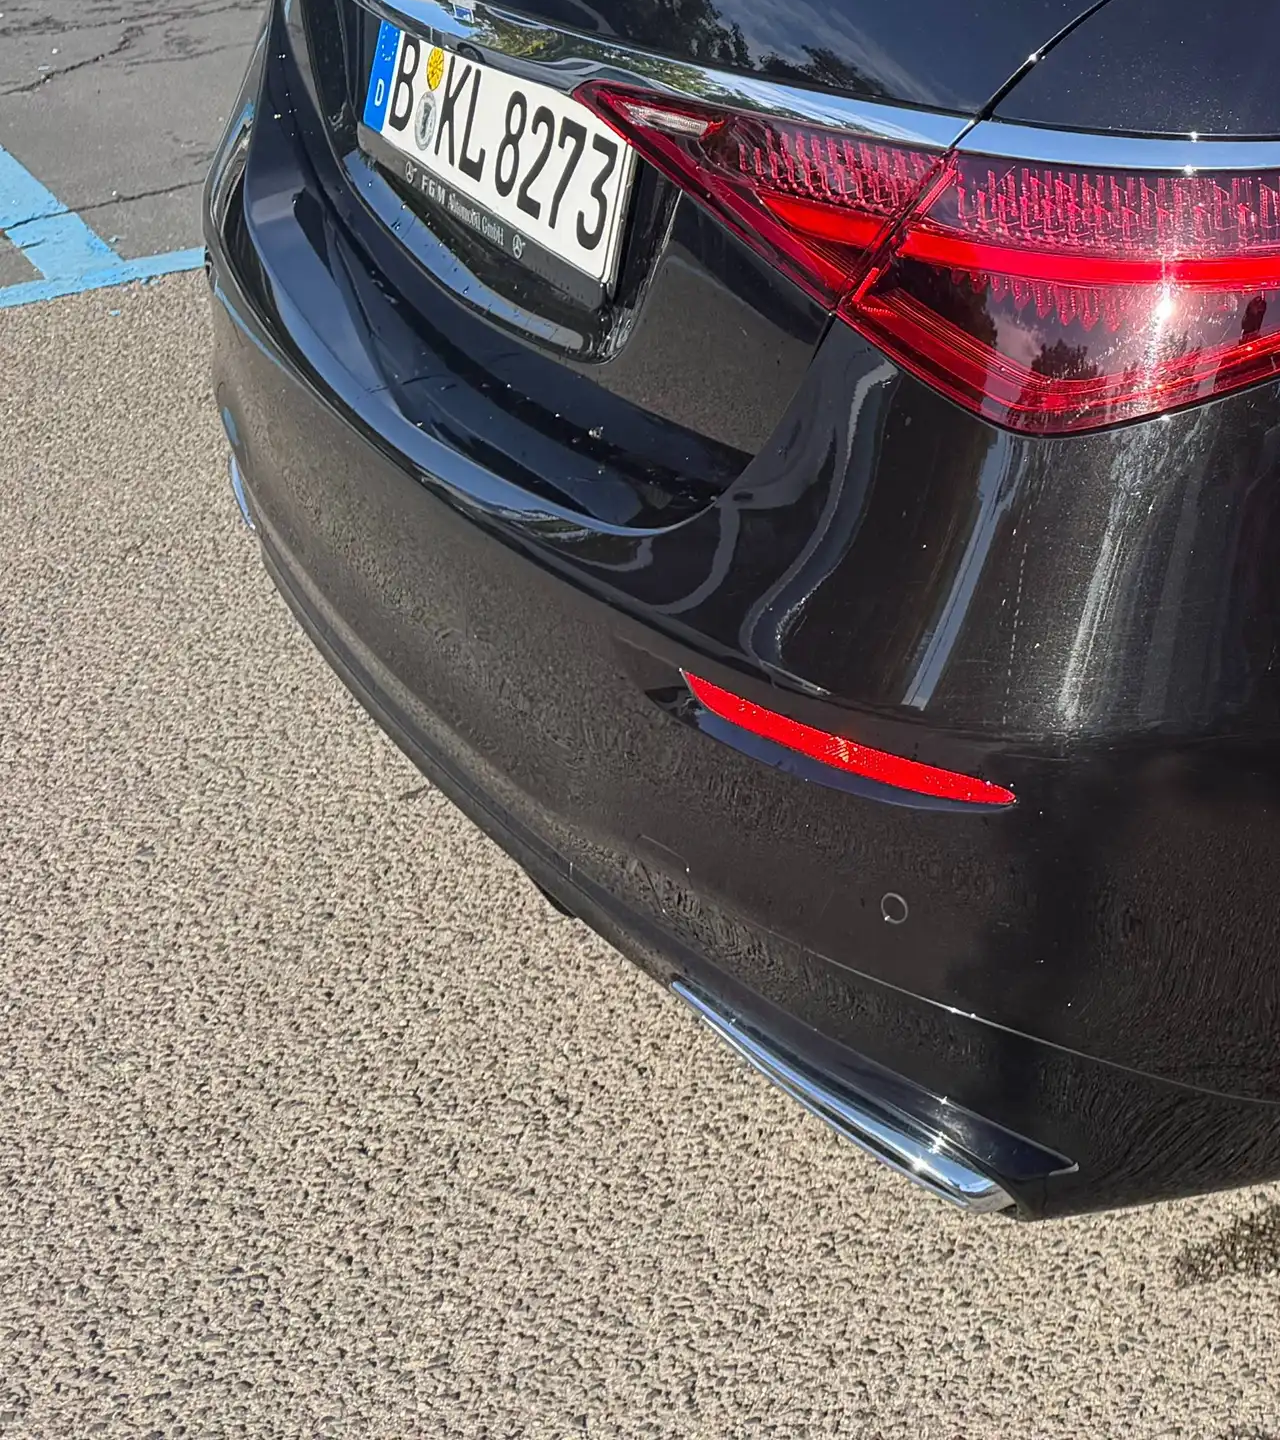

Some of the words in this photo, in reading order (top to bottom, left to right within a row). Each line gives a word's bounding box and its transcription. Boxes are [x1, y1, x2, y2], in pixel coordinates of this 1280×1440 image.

[374, 80, 384, 107] D
[389, 35, 421, 132] B
[434, 55, 486, 182] KL
[494, 91, 618, 250] 8273
[481, 215, 504, 246] GmbH
